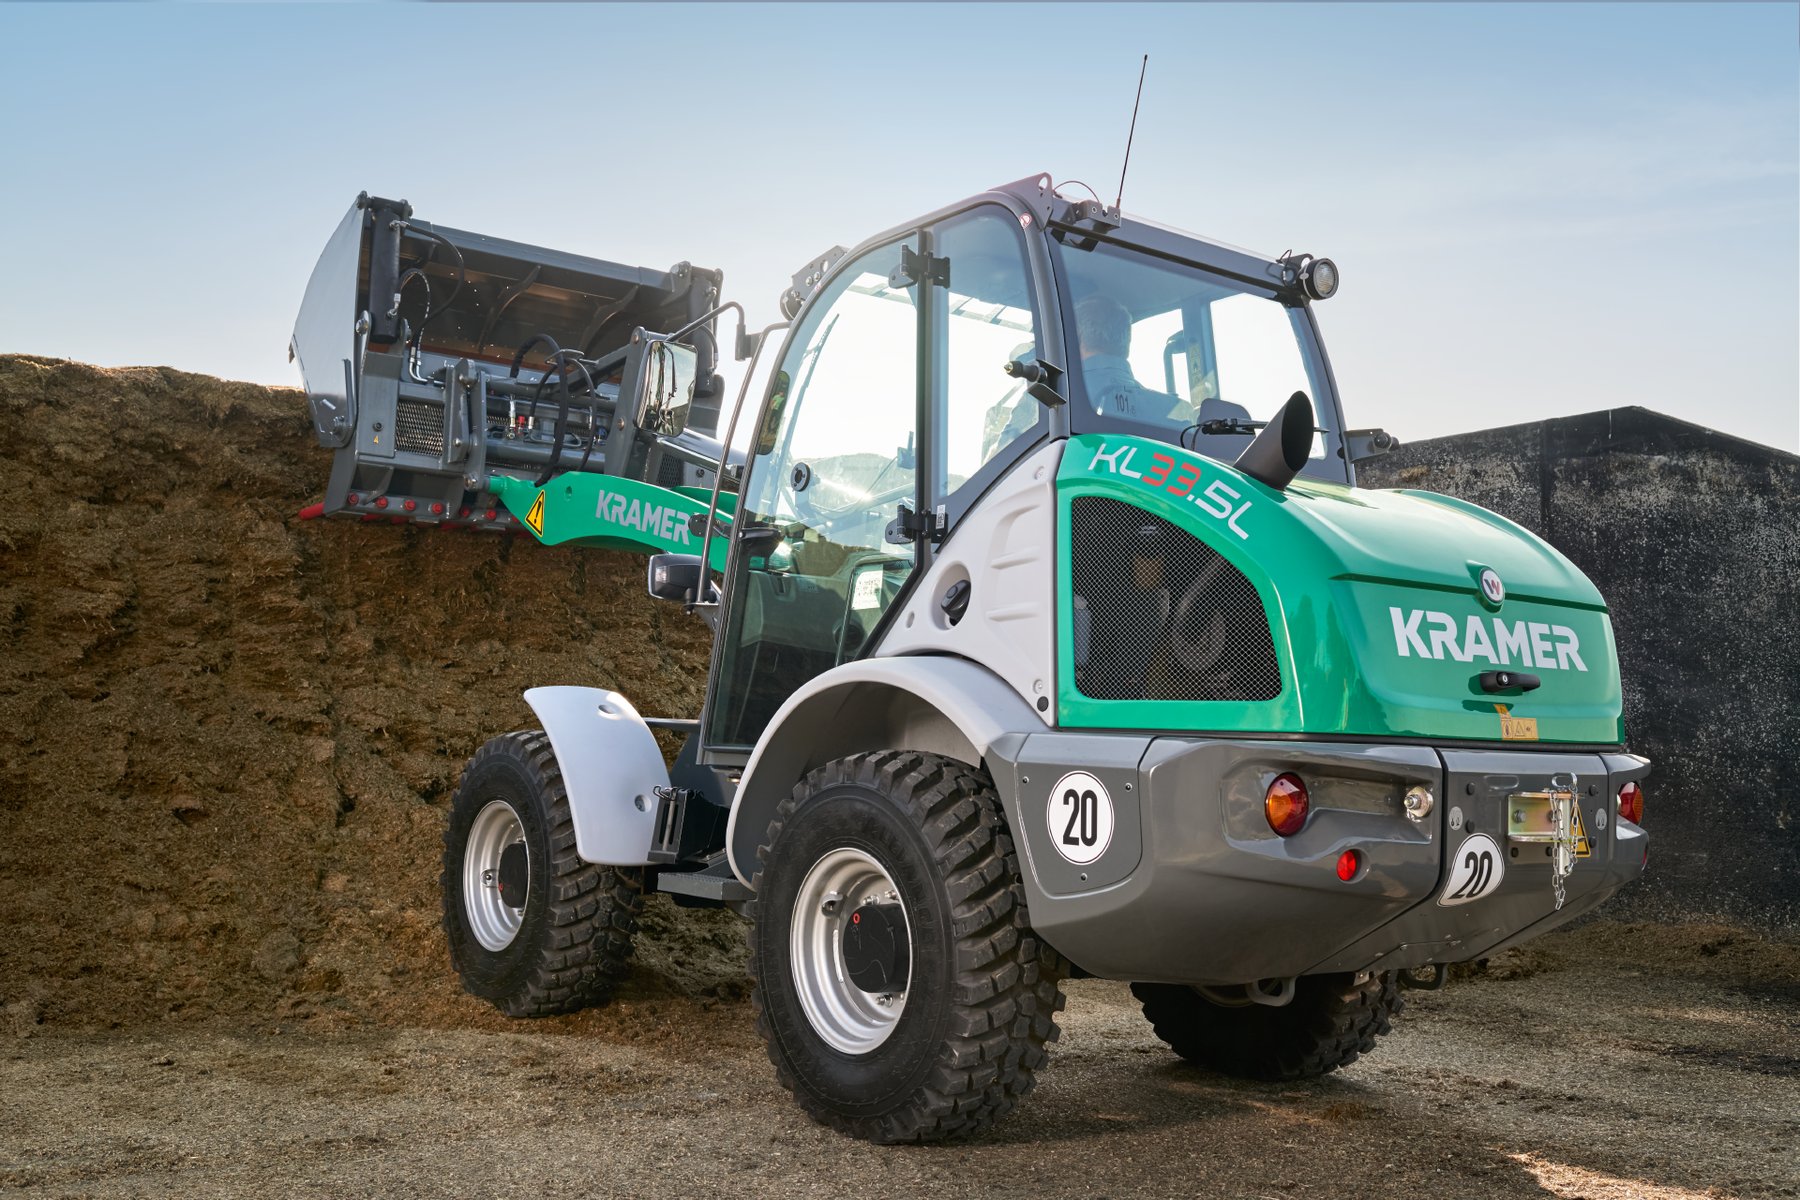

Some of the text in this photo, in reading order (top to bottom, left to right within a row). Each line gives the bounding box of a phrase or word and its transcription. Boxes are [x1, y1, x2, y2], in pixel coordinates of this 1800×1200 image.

[595, 489, 691, 546] KRAMER
[1088, 443, 1253, 540] KL33.5L
[1388, 606, 1589, 673] KRAMER
[1062, 788, 1098, 847] 20
[1450, 850, 1493, 899] 20
